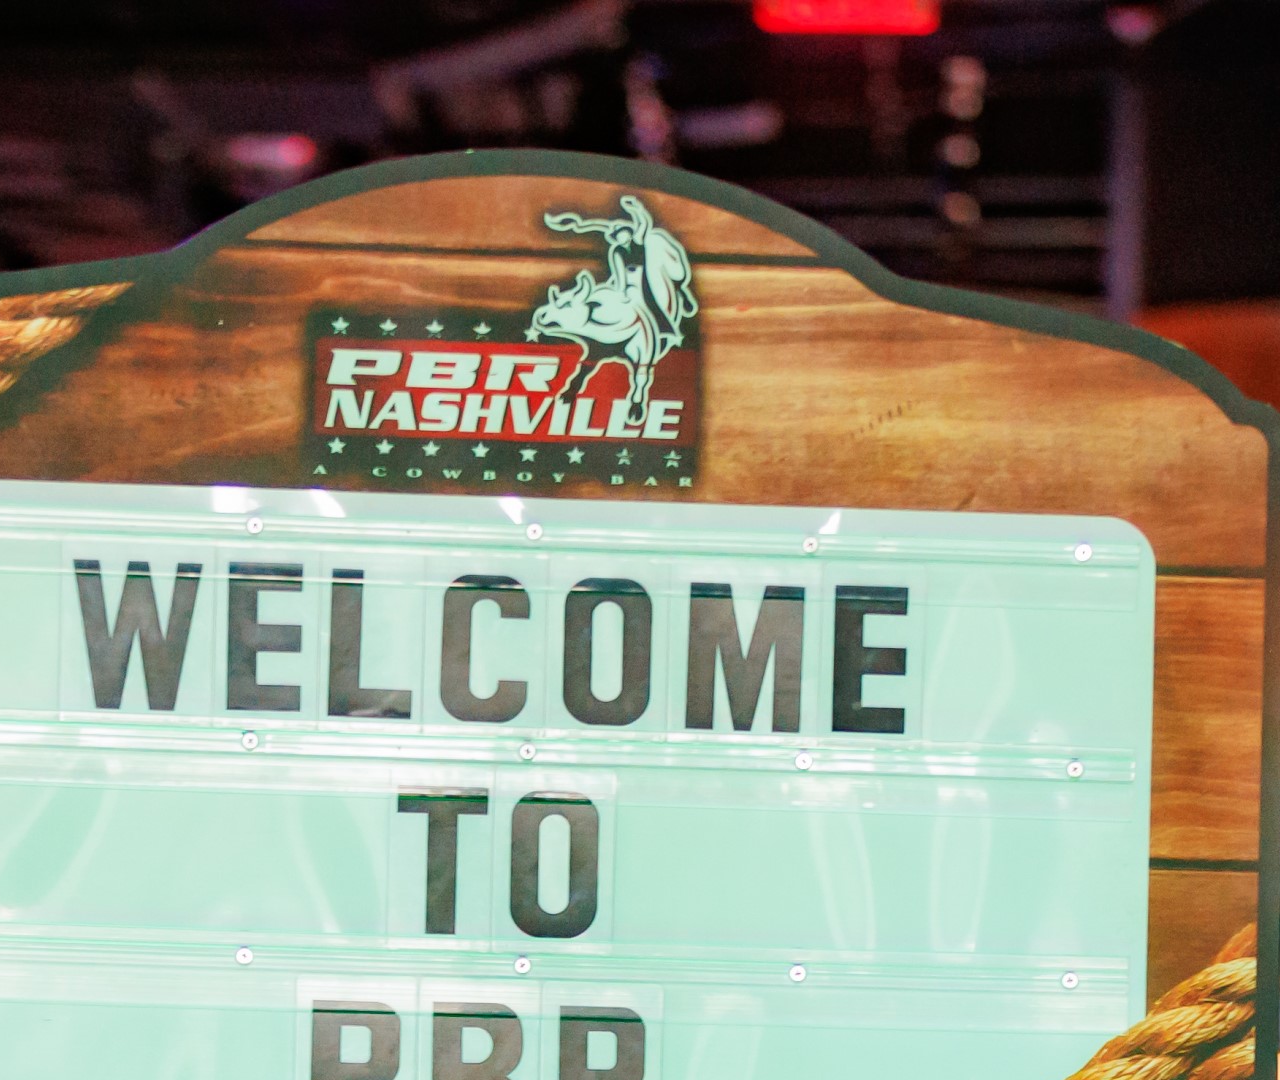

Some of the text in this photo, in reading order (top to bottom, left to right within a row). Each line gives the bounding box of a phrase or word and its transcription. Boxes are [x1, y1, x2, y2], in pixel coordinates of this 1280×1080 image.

[326, 348, 560, 392] PBR
[324, 389, 684, 440] NASHVILLE
[313, 464, 694, 488] A COWBOY BAR
[73, 560, 908, 734] WELCOME
[397, 787, 601, 938] TO
